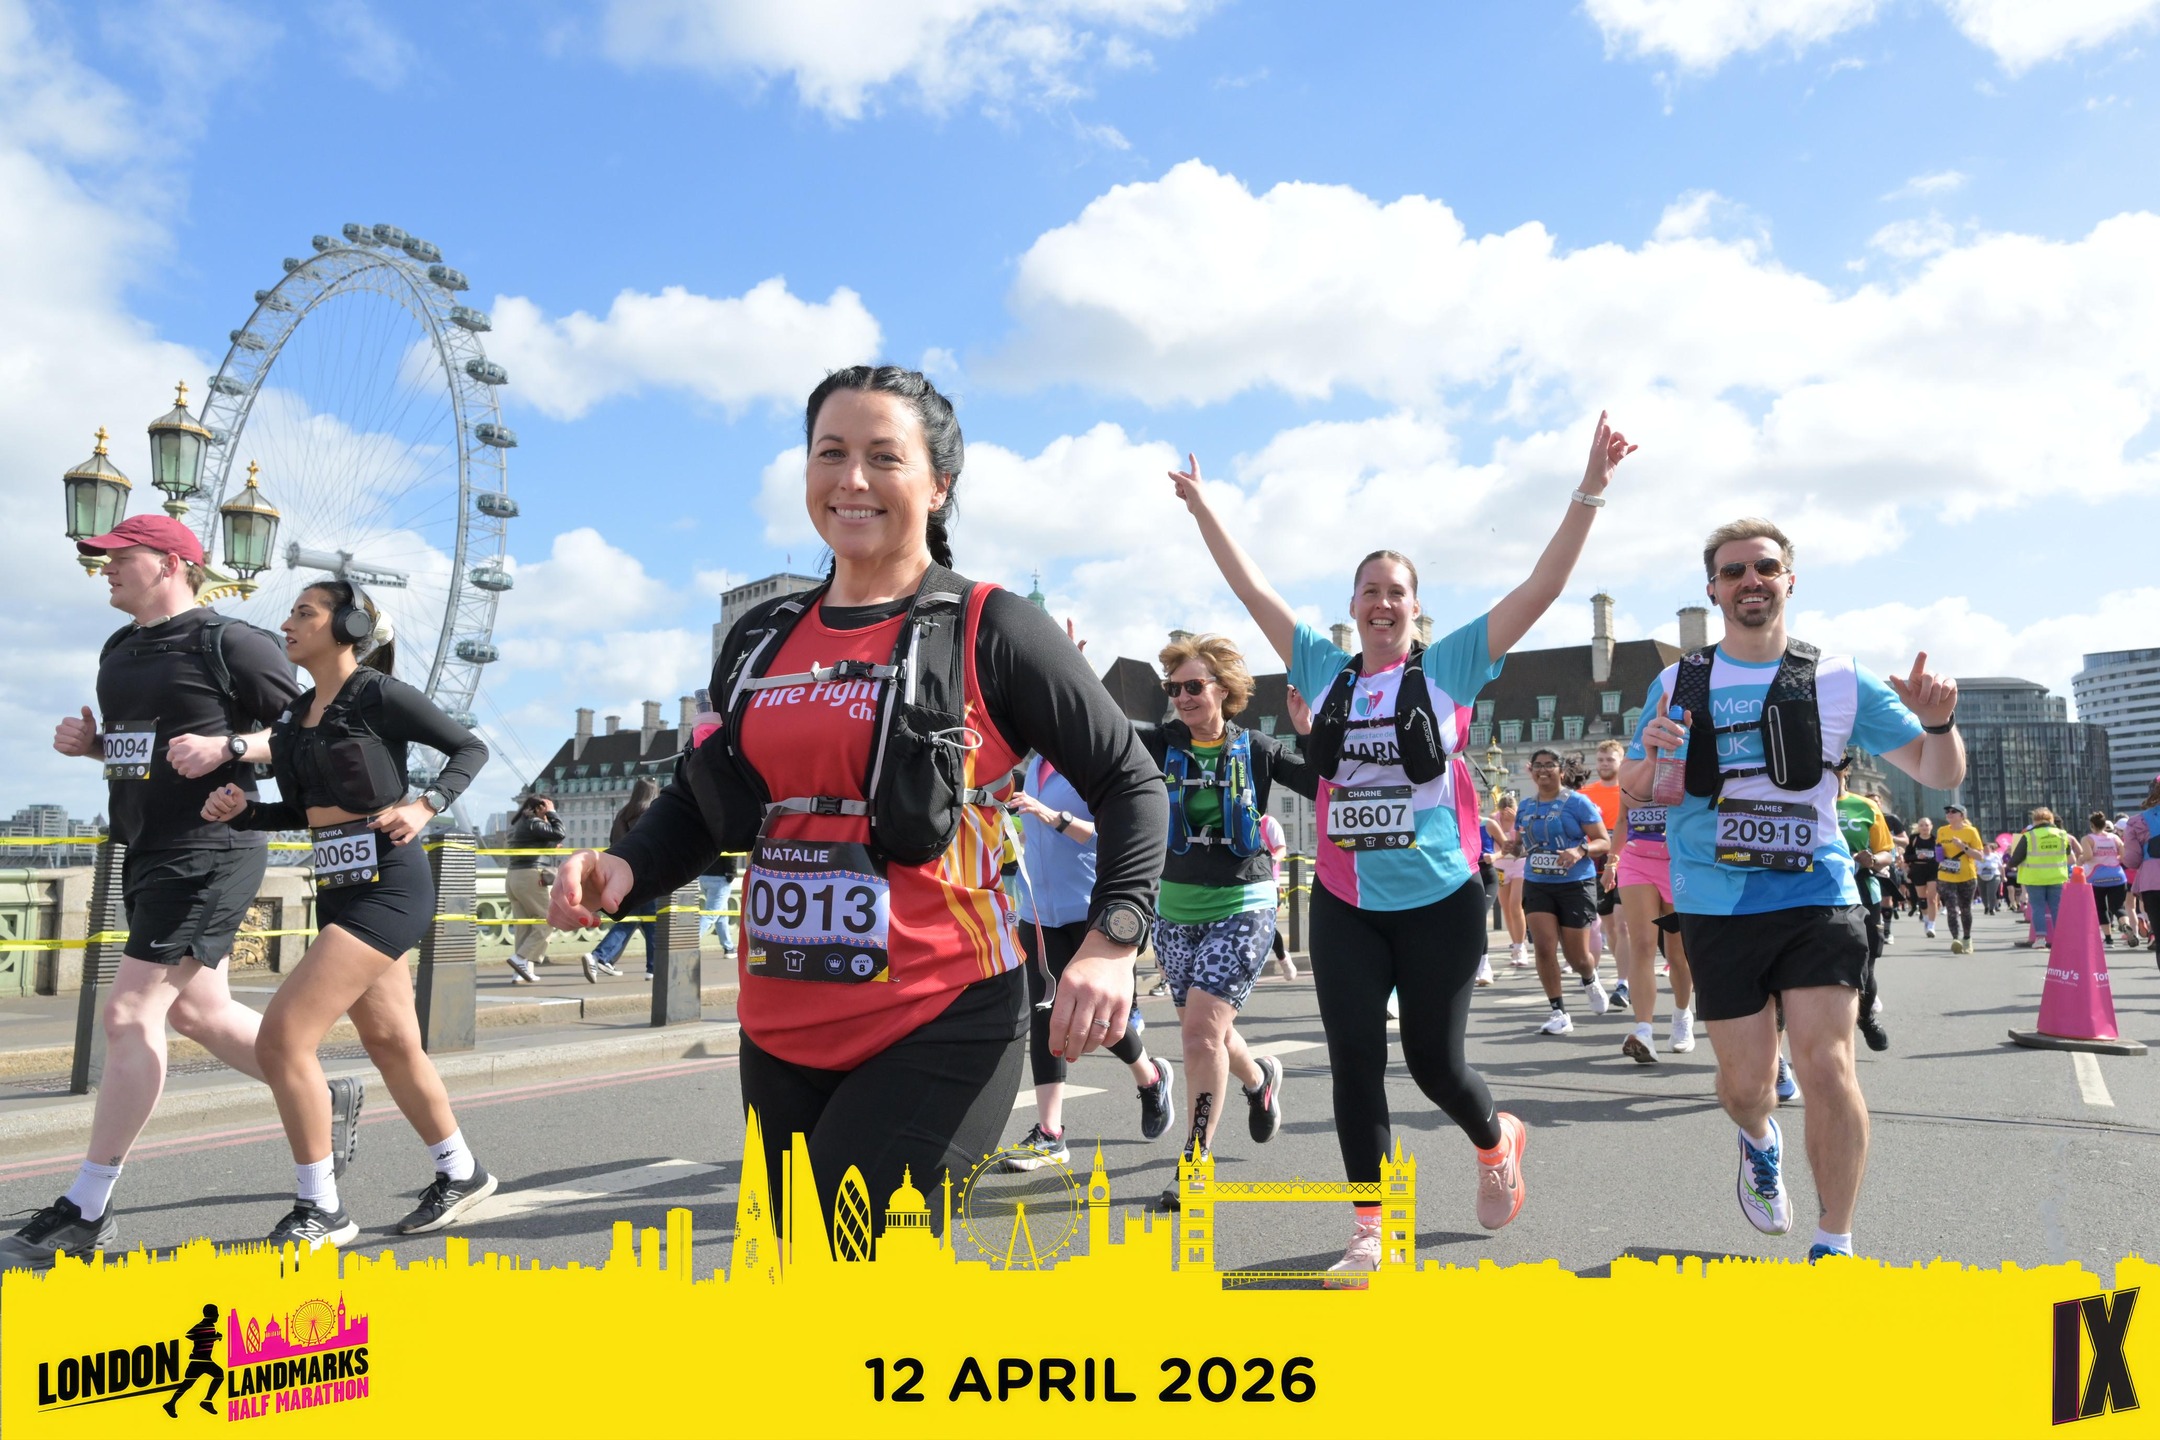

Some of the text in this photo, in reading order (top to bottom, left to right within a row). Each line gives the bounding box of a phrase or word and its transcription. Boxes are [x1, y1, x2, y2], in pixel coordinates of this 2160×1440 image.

[754, 686, 805, 708] Fire
[1716, 736, 1751, 756] UK
[1348, 790, 1382, 798] CHARNE
[1332, 804, 1407, 829] 18607
[1753, 804, 1782, 813] JAMES
[318, 829, 343, 839] DEVIKA
[1721, 818, 1812, 847] 20919
[762, 847, 829, 863] NATALIE
[859, 964, 866, 972] 8
